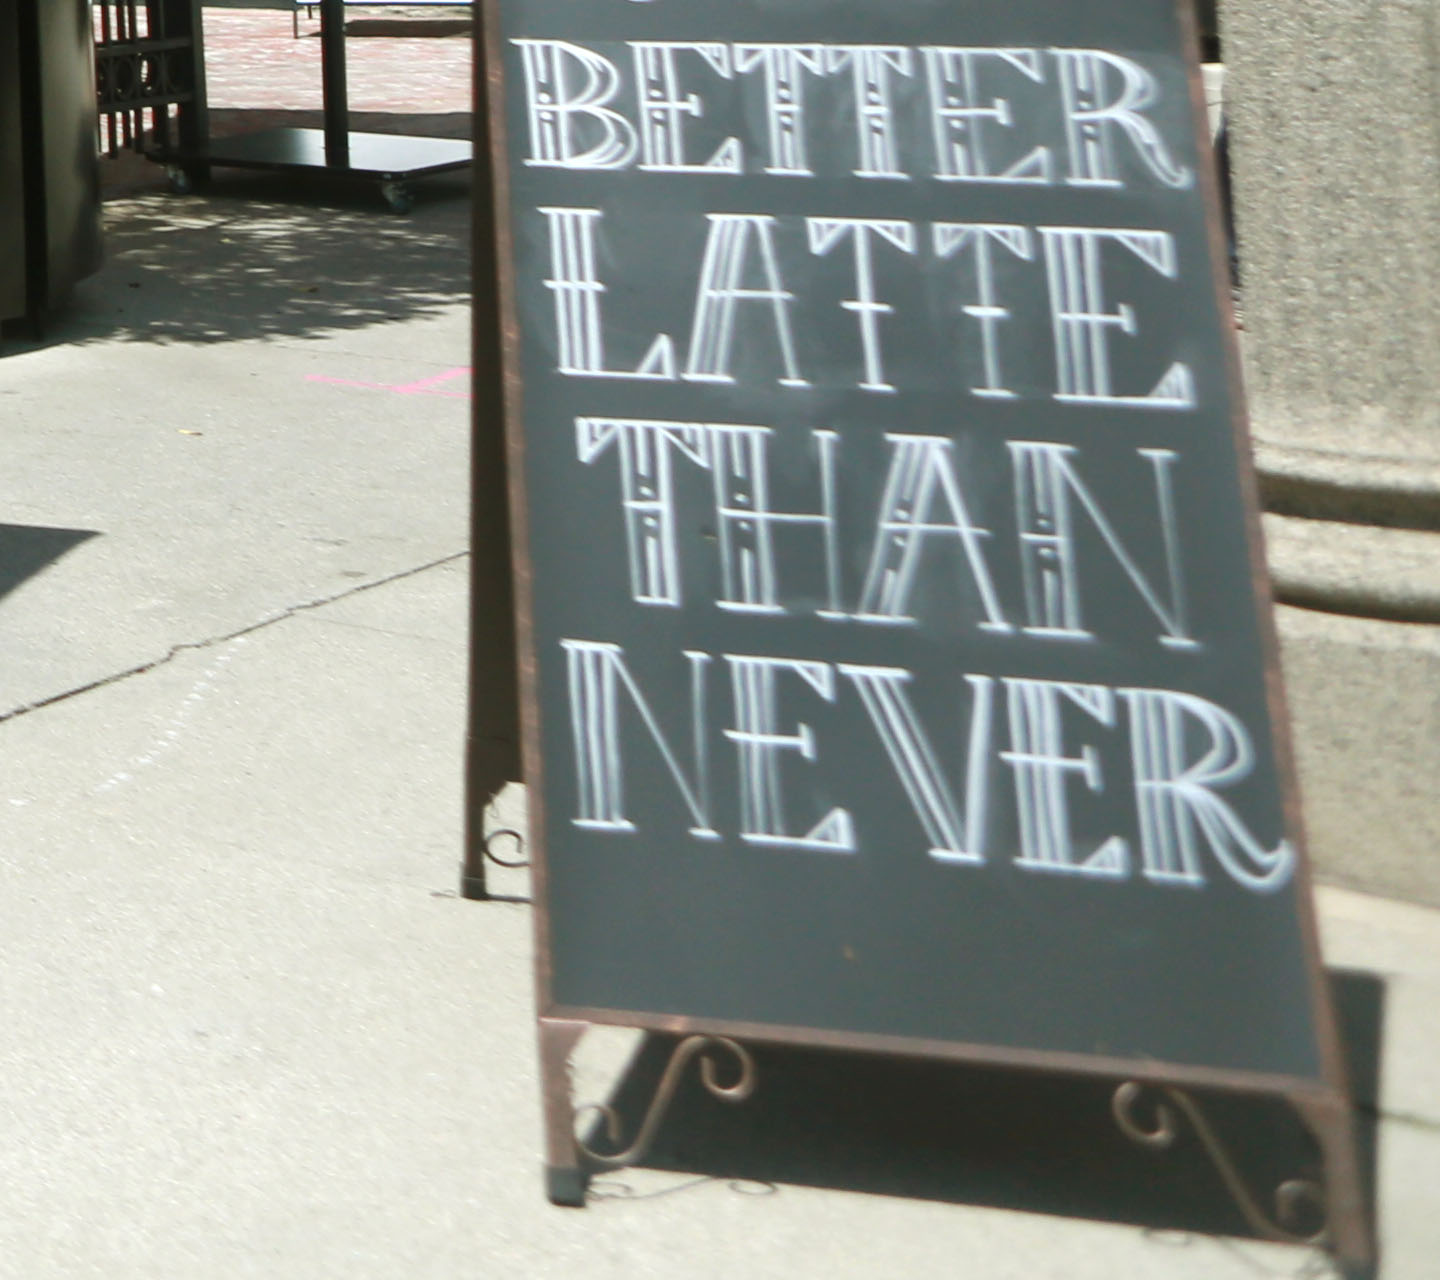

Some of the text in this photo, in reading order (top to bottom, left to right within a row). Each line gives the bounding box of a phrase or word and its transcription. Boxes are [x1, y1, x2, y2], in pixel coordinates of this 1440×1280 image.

[508, 37, 1193, 190] BETTER
[534, 206, 1195, 408] LATTE
[572, 416, 1199, 649] THAN
[559, 639, 1295, 894] NEVER
